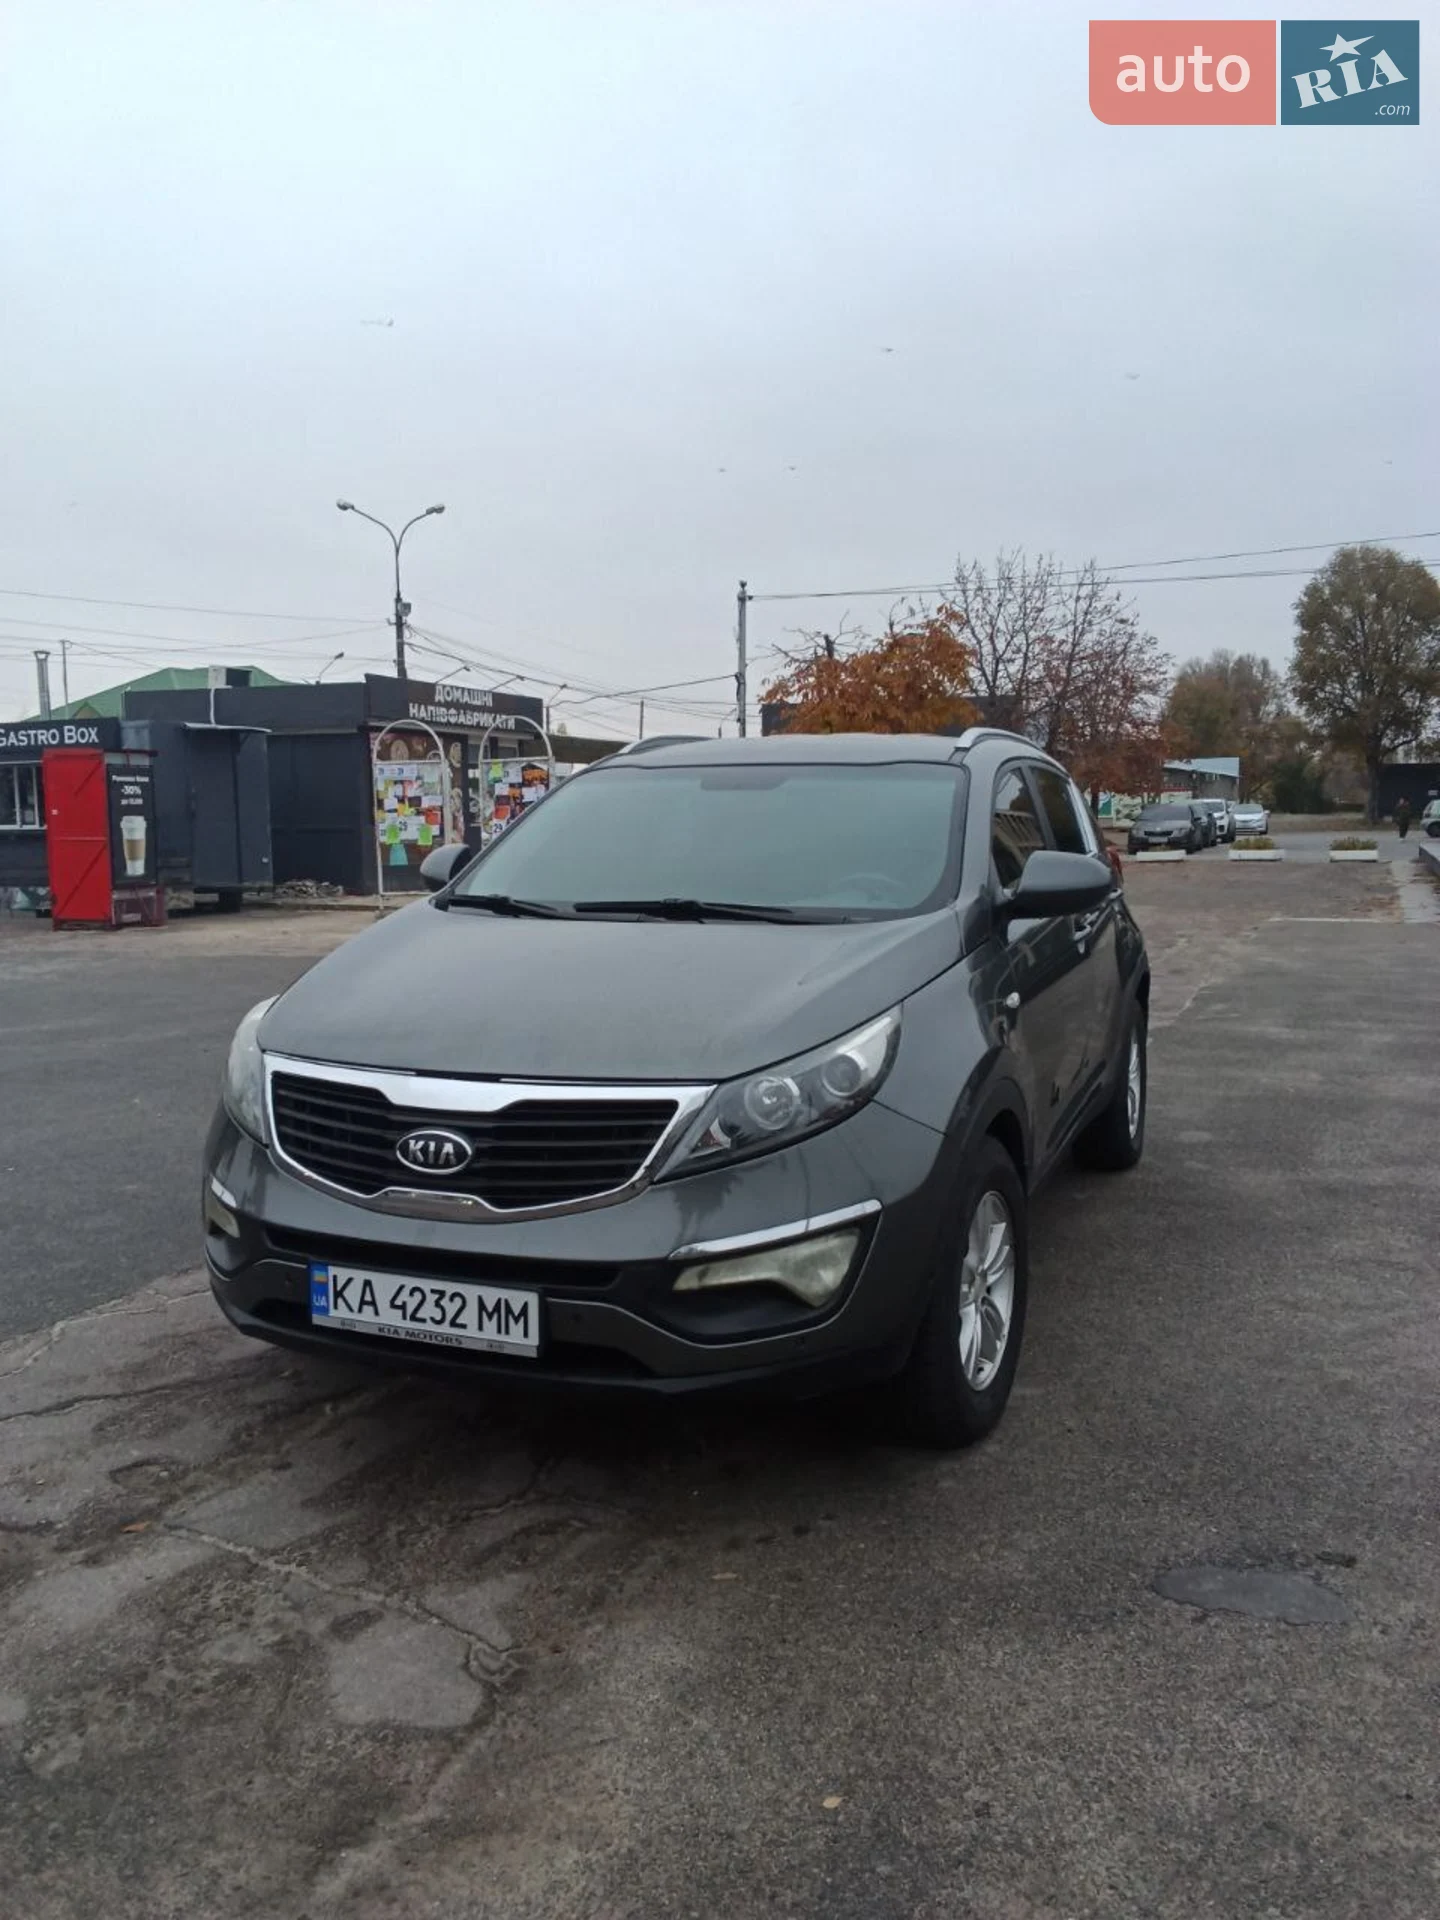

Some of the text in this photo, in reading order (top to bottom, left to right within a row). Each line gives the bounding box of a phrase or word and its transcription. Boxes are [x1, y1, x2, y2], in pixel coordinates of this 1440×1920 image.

[435, 685, 493, 708] ДОМАШНІ
[63, 725, 99, 744] BOX
[408, 1139, 456, 1164] KIA
[313, 1296, 327, 1307] UA
[332, 1274, 529, 1338] KA 4232 MM
[377, 1327, 463, 1345] KIA MOTORS
